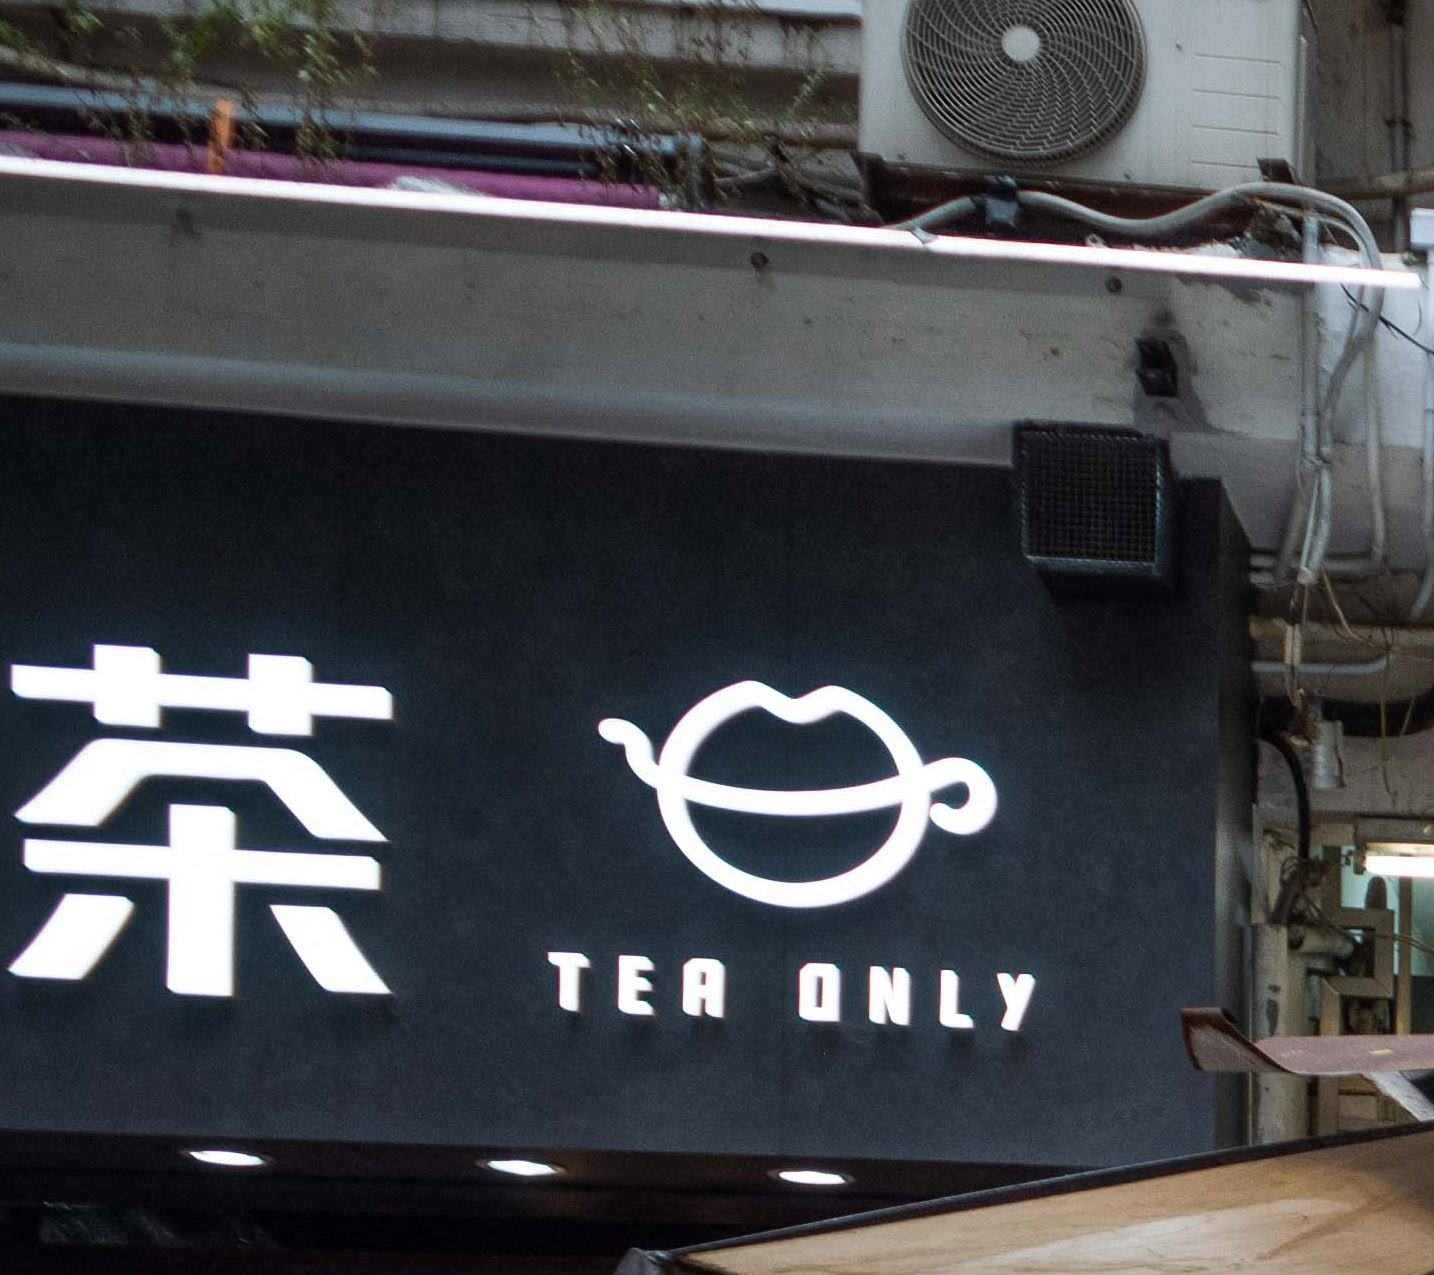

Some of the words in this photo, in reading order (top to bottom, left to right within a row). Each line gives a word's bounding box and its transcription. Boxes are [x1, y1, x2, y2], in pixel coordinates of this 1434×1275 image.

[7, 642, 394, 997] 茶
[546, 951, 727, 1019] TEA
[797, 963, 1037, 1033] ONLY
